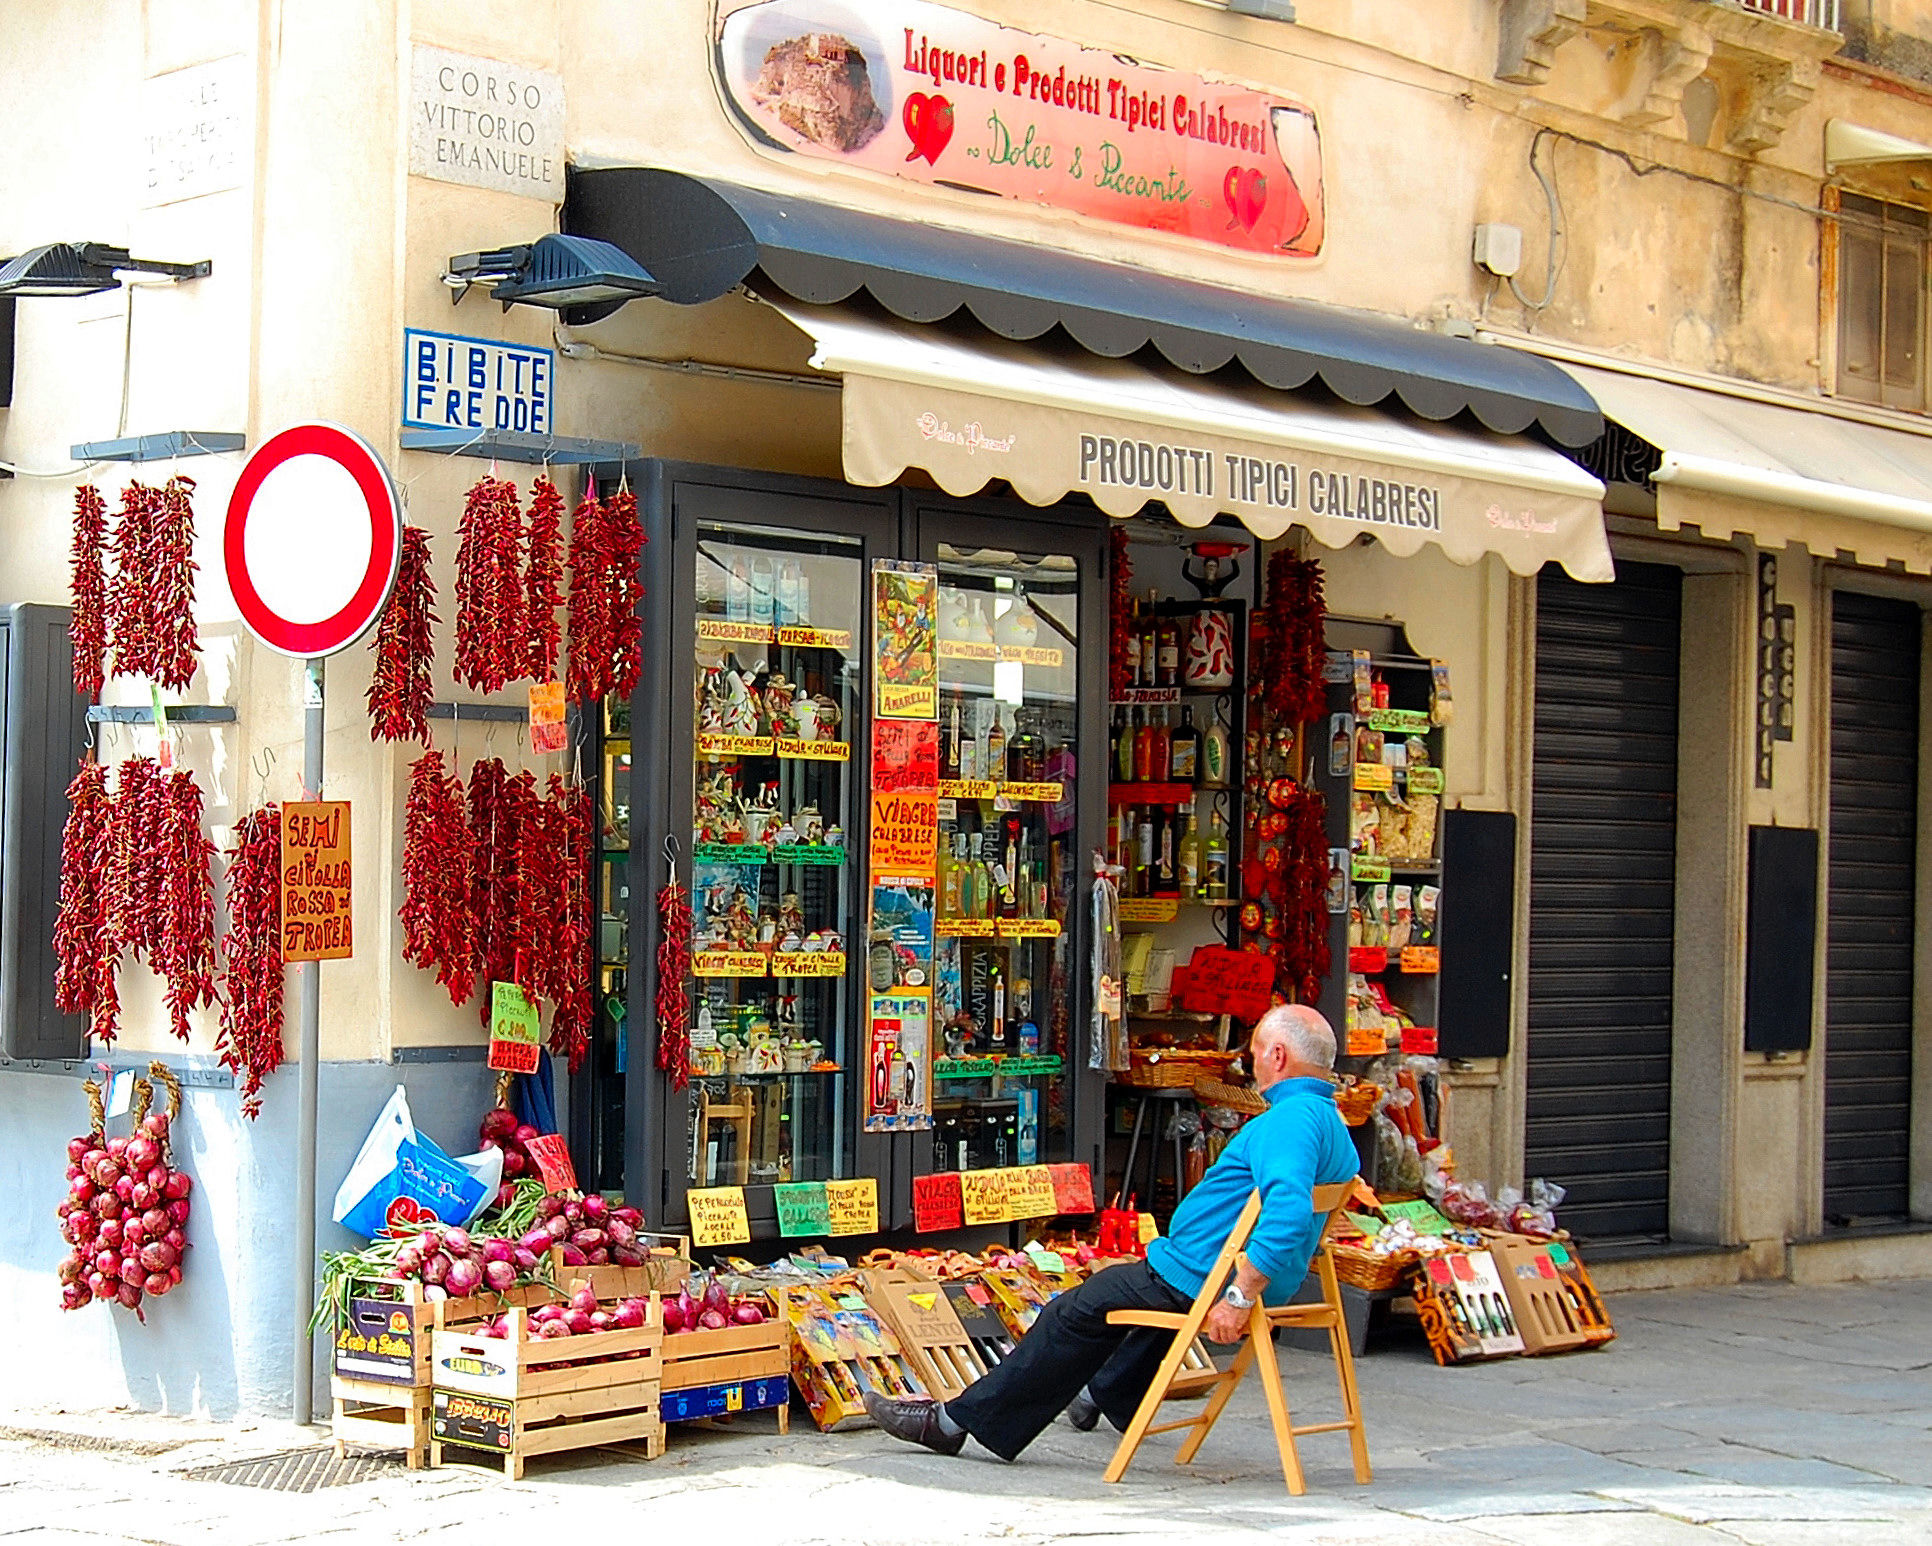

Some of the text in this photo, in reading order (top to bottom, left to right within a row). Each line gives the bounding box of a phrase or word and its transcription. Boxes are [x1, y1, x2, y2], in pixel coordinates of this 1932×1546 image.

[439, 67, 541, 109] CORSO
[904, 27, 1266, 155] Liquori e Prodotti Tipici Calabresi
[424, 102, 536, 146] VITTORIO
[437, 138, 552, 182] EMANUELE
[987, 109, 1053, 170] Dolce
[1094, 139, 1194, 202] Piccante
[417, 384, 545, 434] FREDDE
[1080, 434, 1441, 531] PRODOTTI TIPICI CALABRESI
[286, 890, 335, 917] ROSSA
[285, 915, 352, 951] TROPEA
